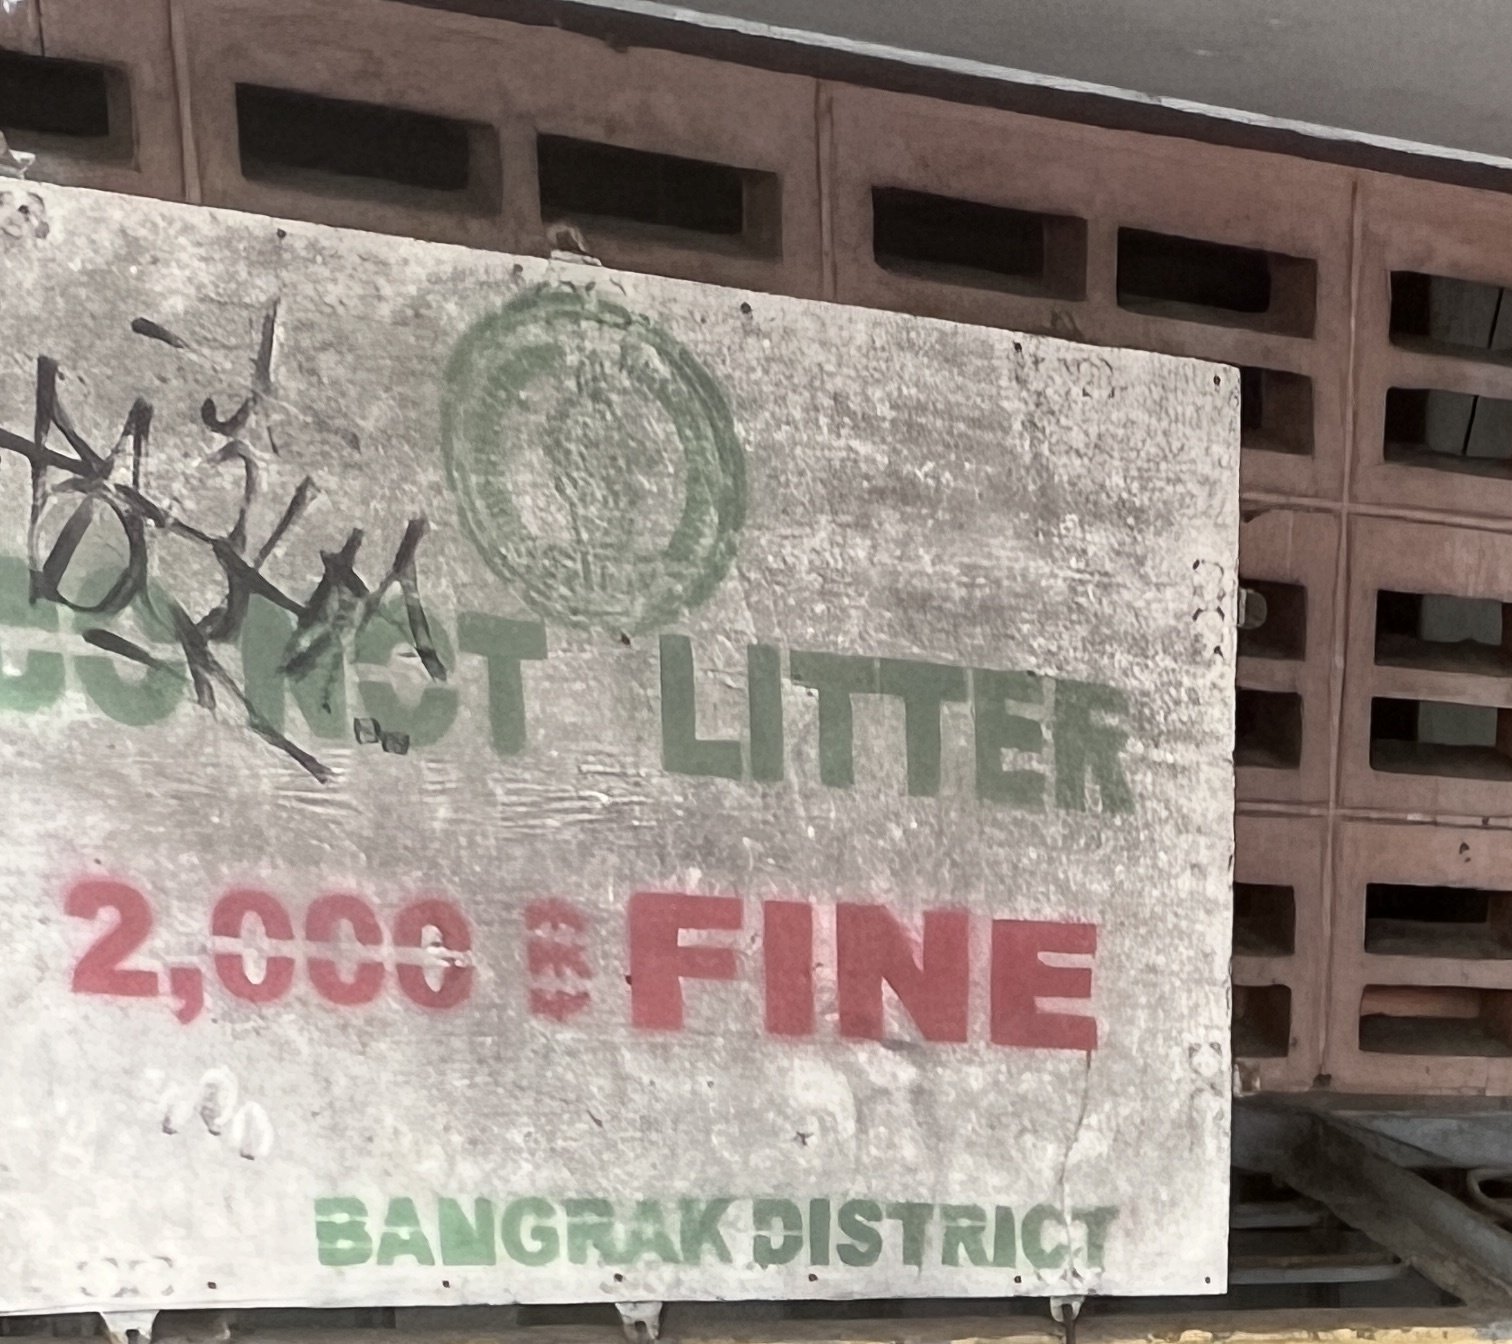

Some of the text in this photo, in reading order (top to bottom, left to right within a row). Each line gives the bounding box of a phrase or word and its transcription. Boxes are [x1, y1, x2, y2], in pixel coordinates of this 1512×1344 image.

[243, 592, 548, 755] NOT
[660, 634, 1136, 814] LITTER
[65, 880, 474, 1023] 2,000
[629, 892, 1097, 1050] FINE
[314, 1196, 1119, 1268] BANGRAK DISTRICT
